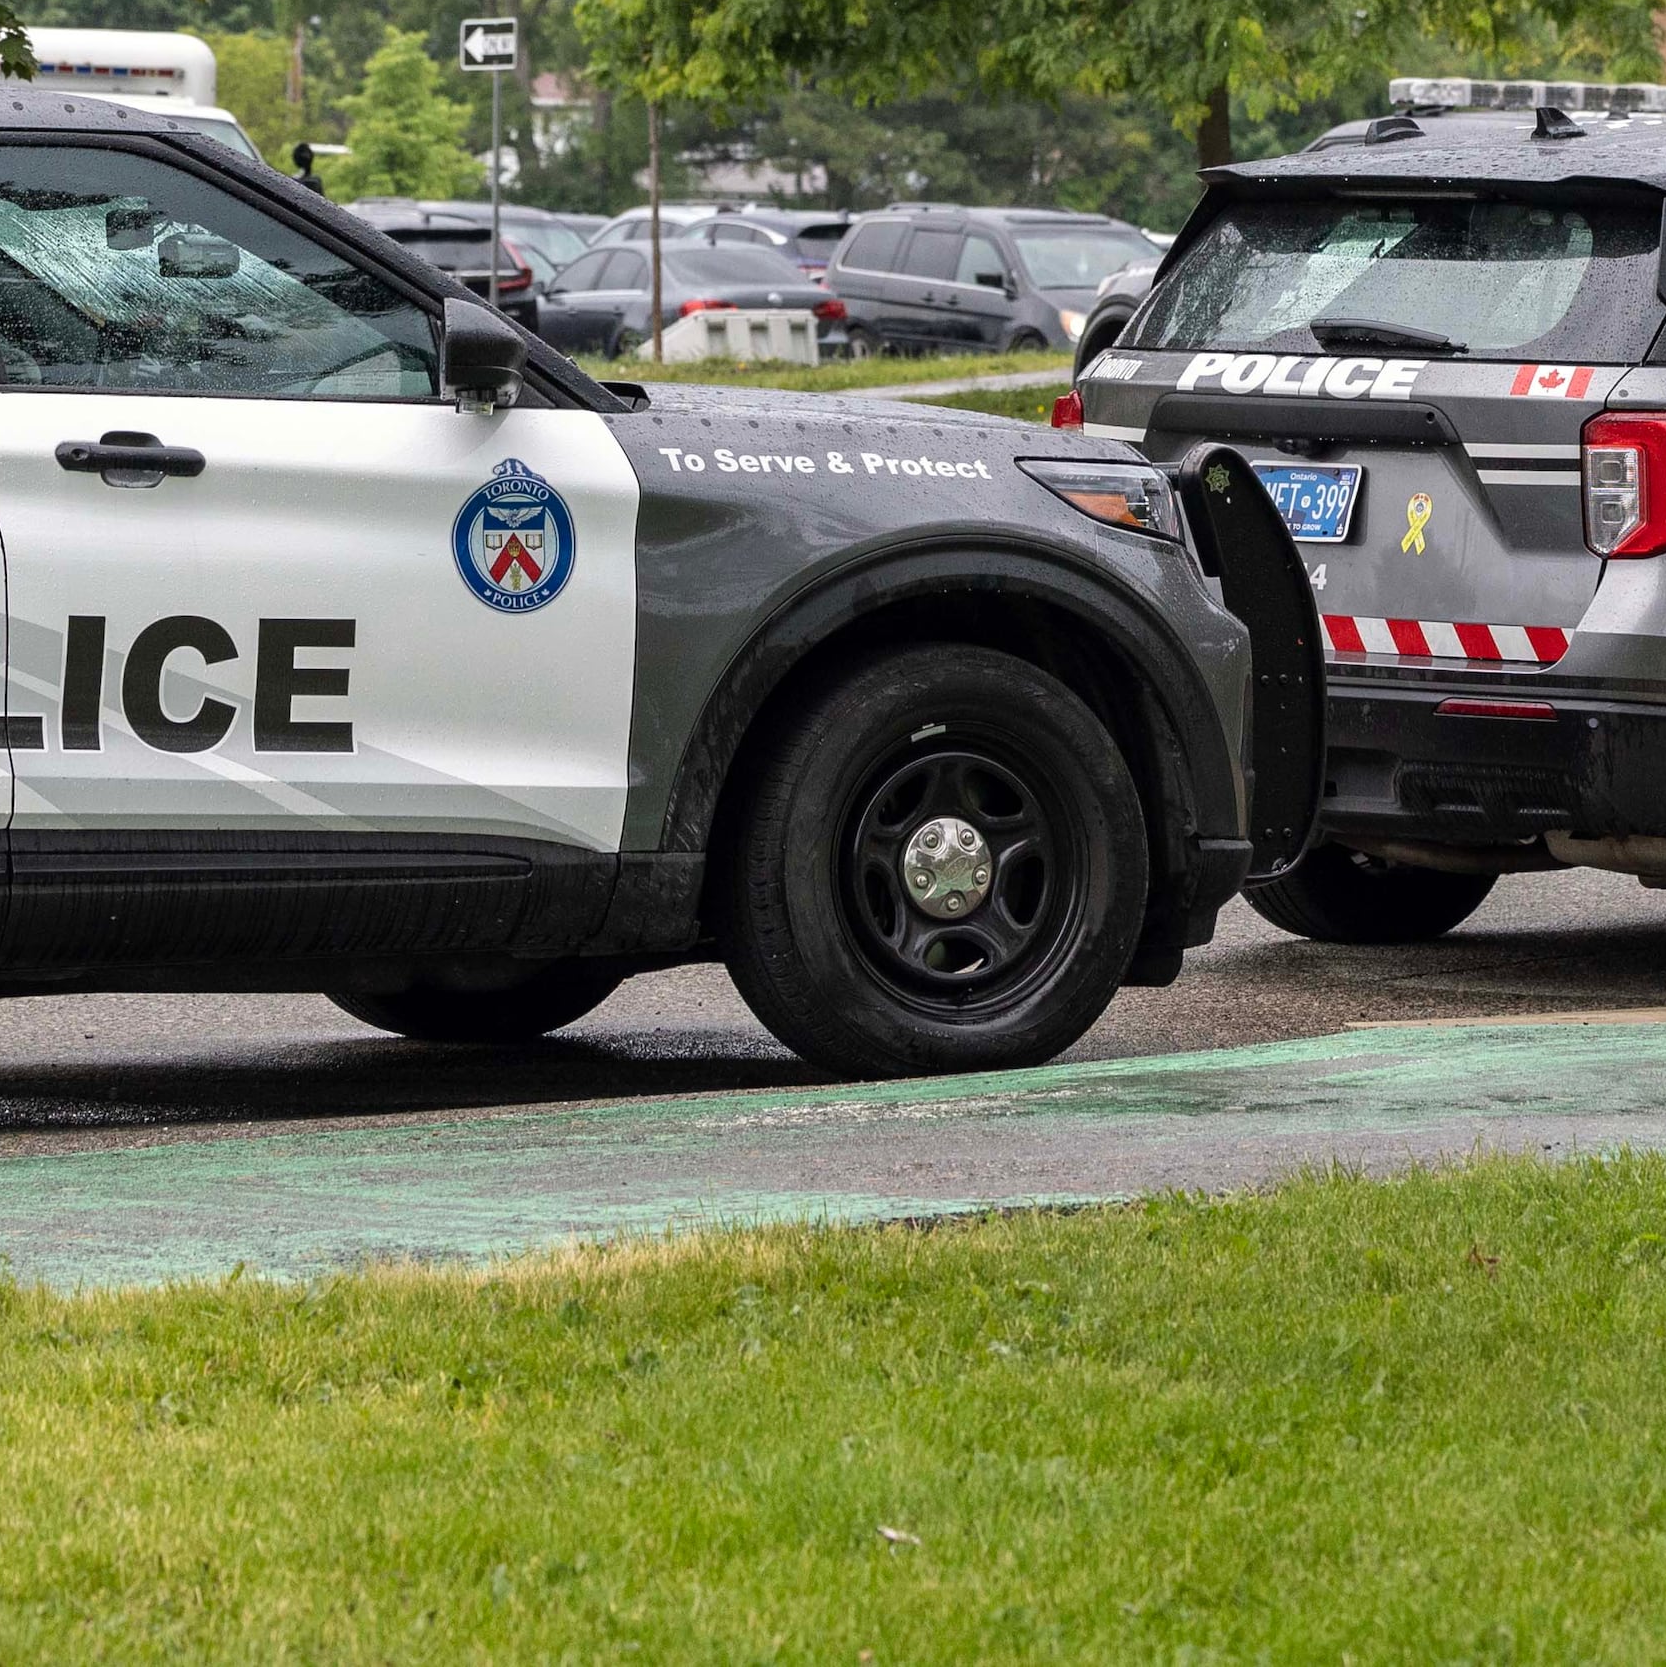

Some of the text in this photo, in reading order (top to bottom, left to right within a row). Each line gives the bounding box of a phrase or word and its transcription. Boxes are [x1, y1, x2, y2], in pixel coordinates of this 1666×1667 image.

[1091, 355, 1143, 380] TORONTO
[1176, 353, 1429, 400] POLICE
[659, 448, 993, 480] To Serve & Protect
[1290, 473, 1318, 481] Ontario
[483, 480, 549, 501] TORONTO
[1312, 484, 1350, 520] 399
[492, 592, 542, 609] POLICE
